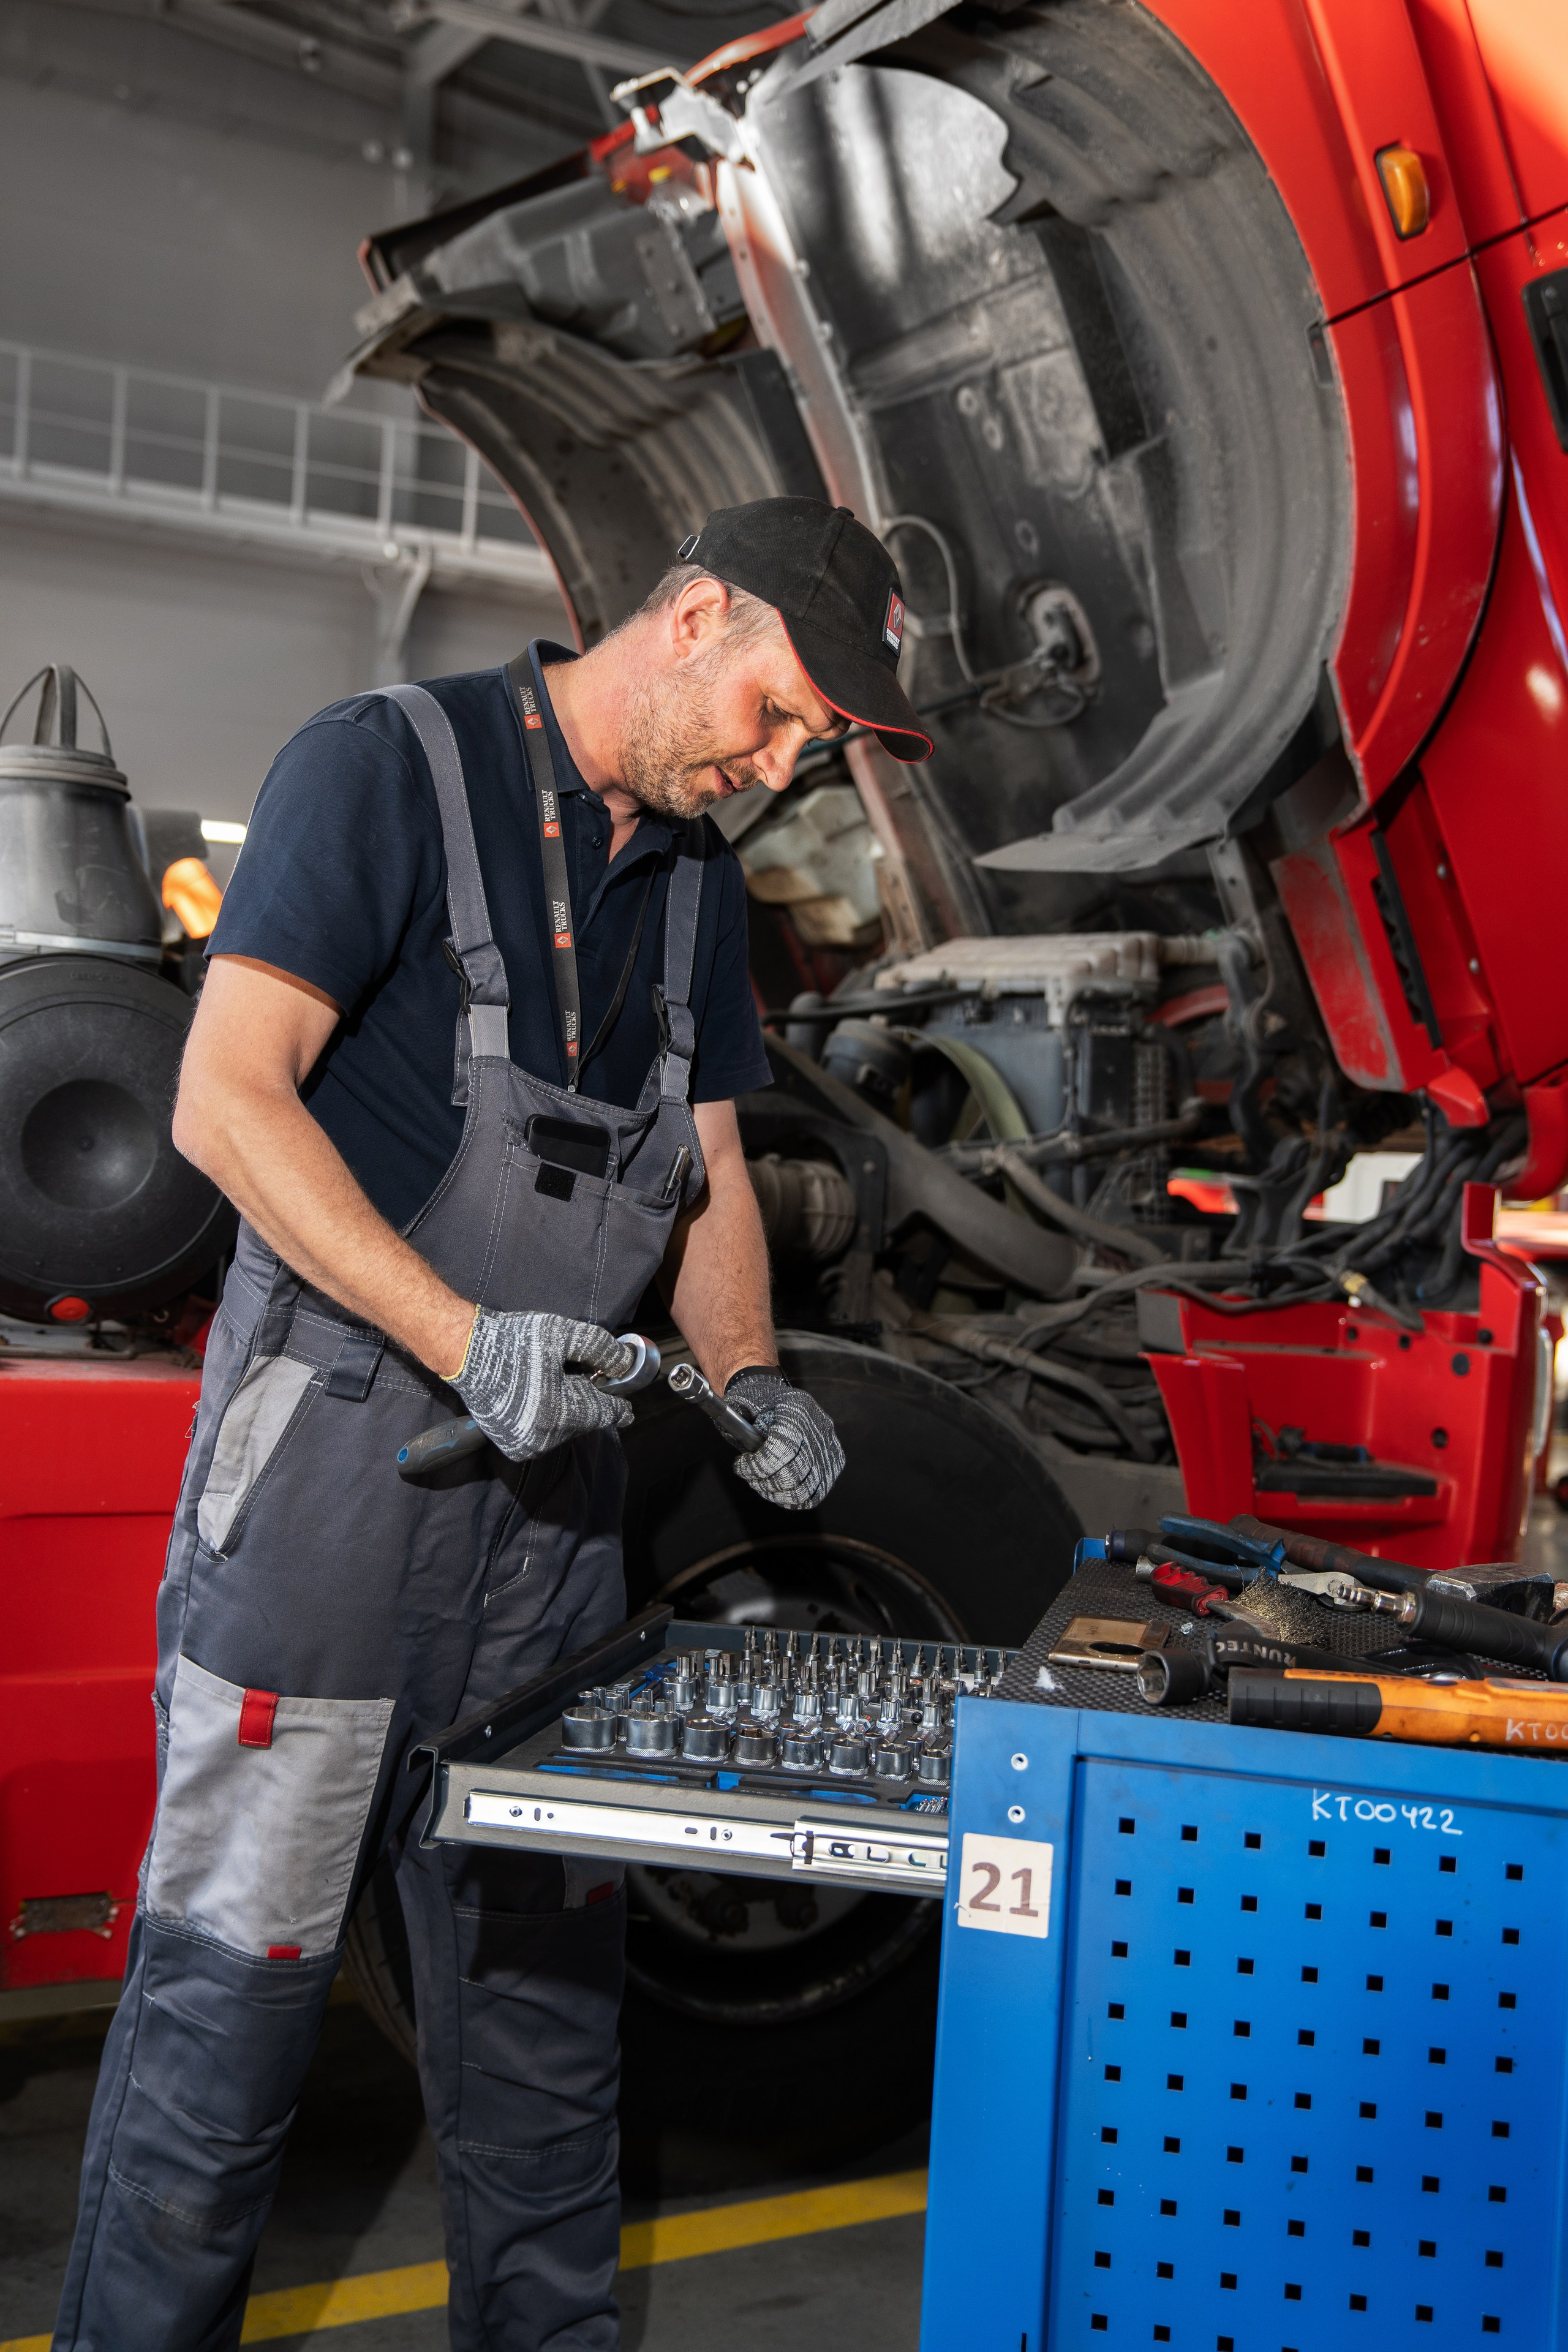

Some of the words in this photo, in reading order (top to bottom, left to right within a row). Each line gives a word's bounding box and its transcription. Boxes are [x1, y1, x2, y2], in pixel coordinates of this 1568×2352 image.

[519, 687, 531, 715] RENAULT
[526, 687, 537, 713] TRUCKS
[541, 790, 551, 822] RENAULT
[547, 791, 556, 820] TRUCKS
[552, 900, 561, 933] RENAULT
[559, 902, 567, 931] TRUCKS
[1312, 1788, 1463, 1835] KT00422
[969, 1861, 1039, 1918] 21
